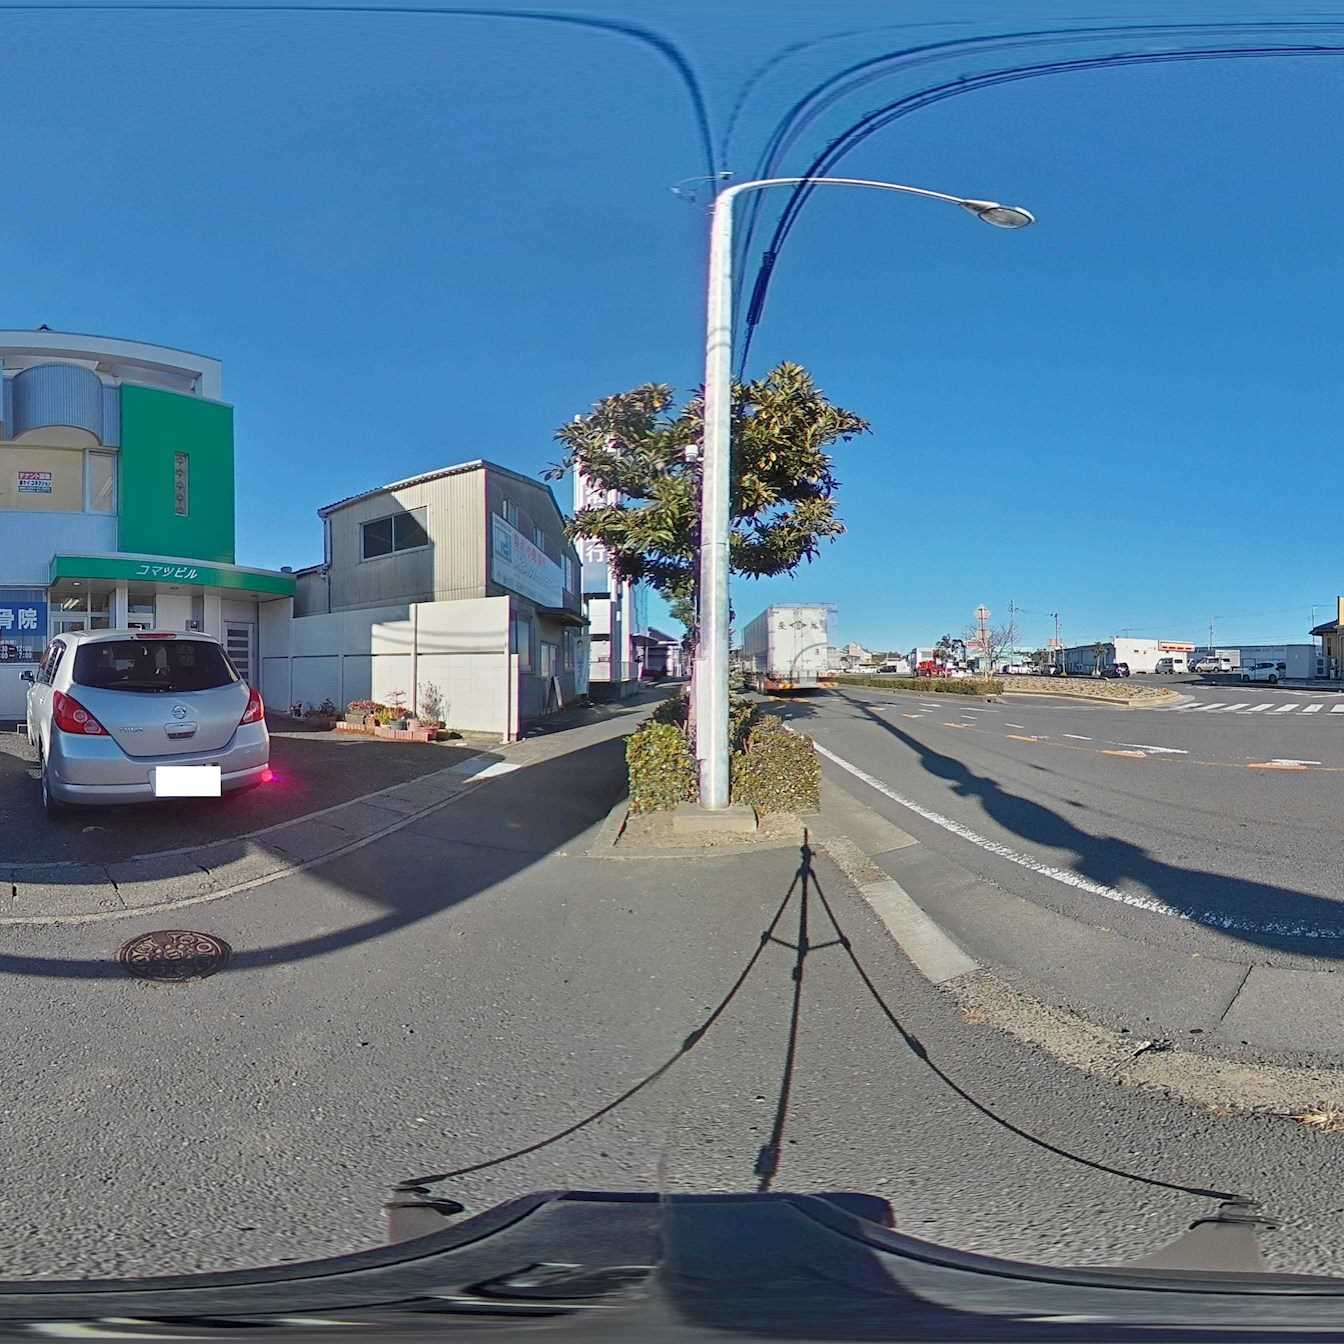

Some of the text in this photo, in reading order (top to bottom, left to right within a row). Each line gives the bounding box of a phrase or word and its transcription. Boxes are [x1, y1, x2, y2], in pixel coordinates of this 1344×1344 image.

[136, 565, 198, 579] コマツビル
